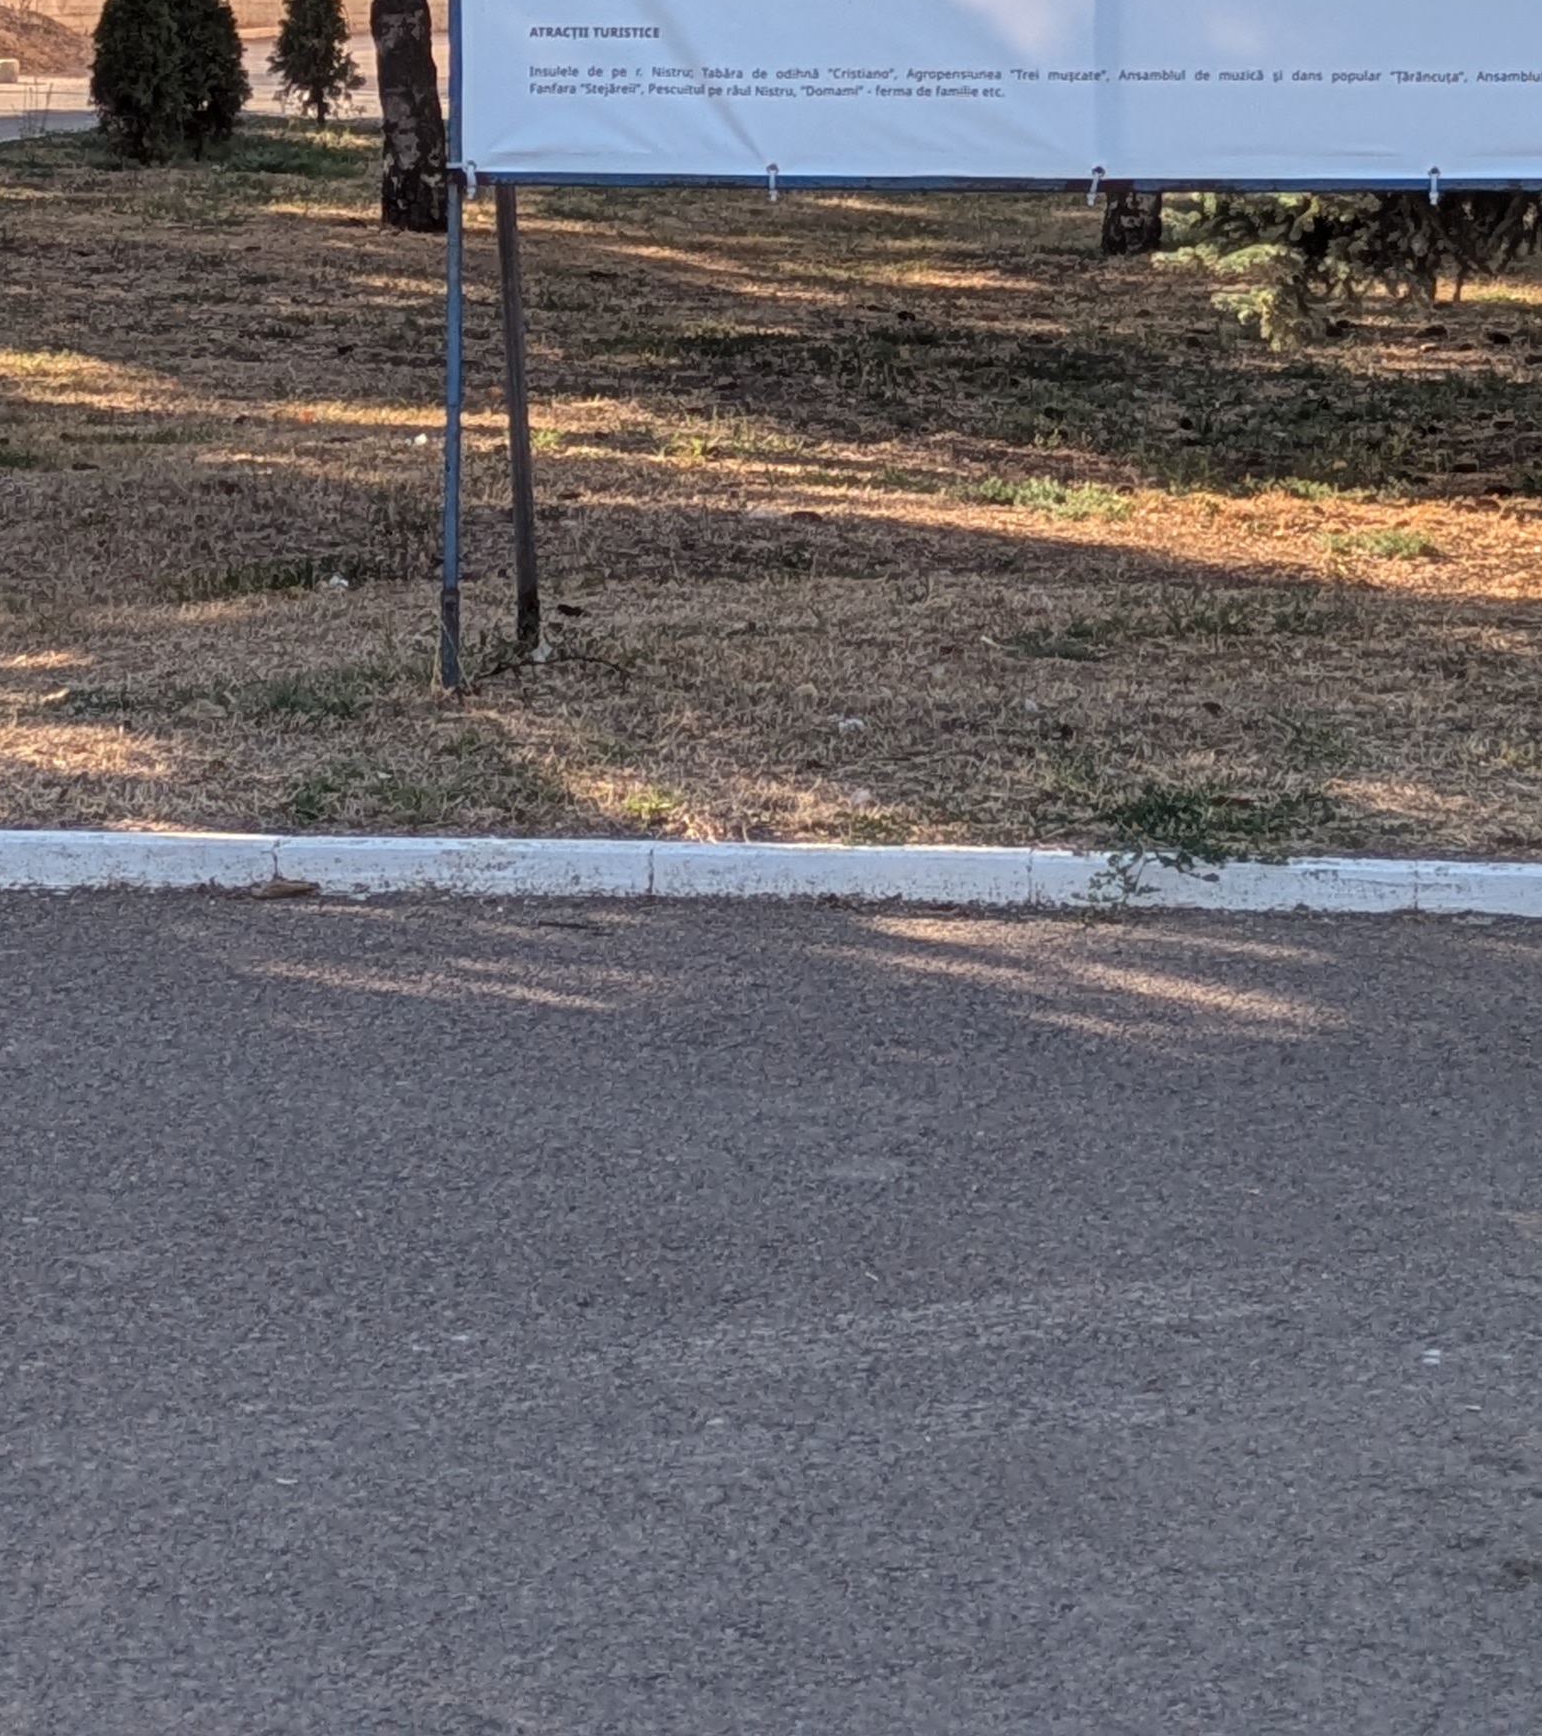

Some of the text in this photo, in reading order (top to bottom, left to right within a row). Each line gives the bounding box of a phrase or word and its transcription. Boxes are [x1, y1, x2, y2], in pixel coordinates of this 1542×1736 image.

[529, 26, 661, 40] ATRACȚII TURISTICE
[529, 65, 580, 77] Insulele
[586, 66, 604, 78] de
[610, 68, 628, 80] pe
[634, 68, 644, 78] r.
[700, 67, 744, 79] Tabăra
[751, 67, 769, 79] de
[775, 67, 820, 79] odihnă
[905, 68, 1003, 82] Agropensiunea
[1117, 69, 1187, 81] Ansamblul
[1193, 69, 1211, 81] de
[1218, 69, 1265, 81] muzică
[1272, 69, 1284, 83] și
[1291, 69, 1324, 81] dans
[1330, 69, 1383, 83] popular
[529, 82, 577, 94] Fanfara
[647, 83, 706, 95] Pescuitul
[707, 86, 724, 98] pe
[754, 84, 798, 98] Nistru,
[874, 85, 913, 97] ferma
[915, 85, 933, 97] de
[935, 85, 979, 97] familie
[981, 85, 1006, 97] etc.
